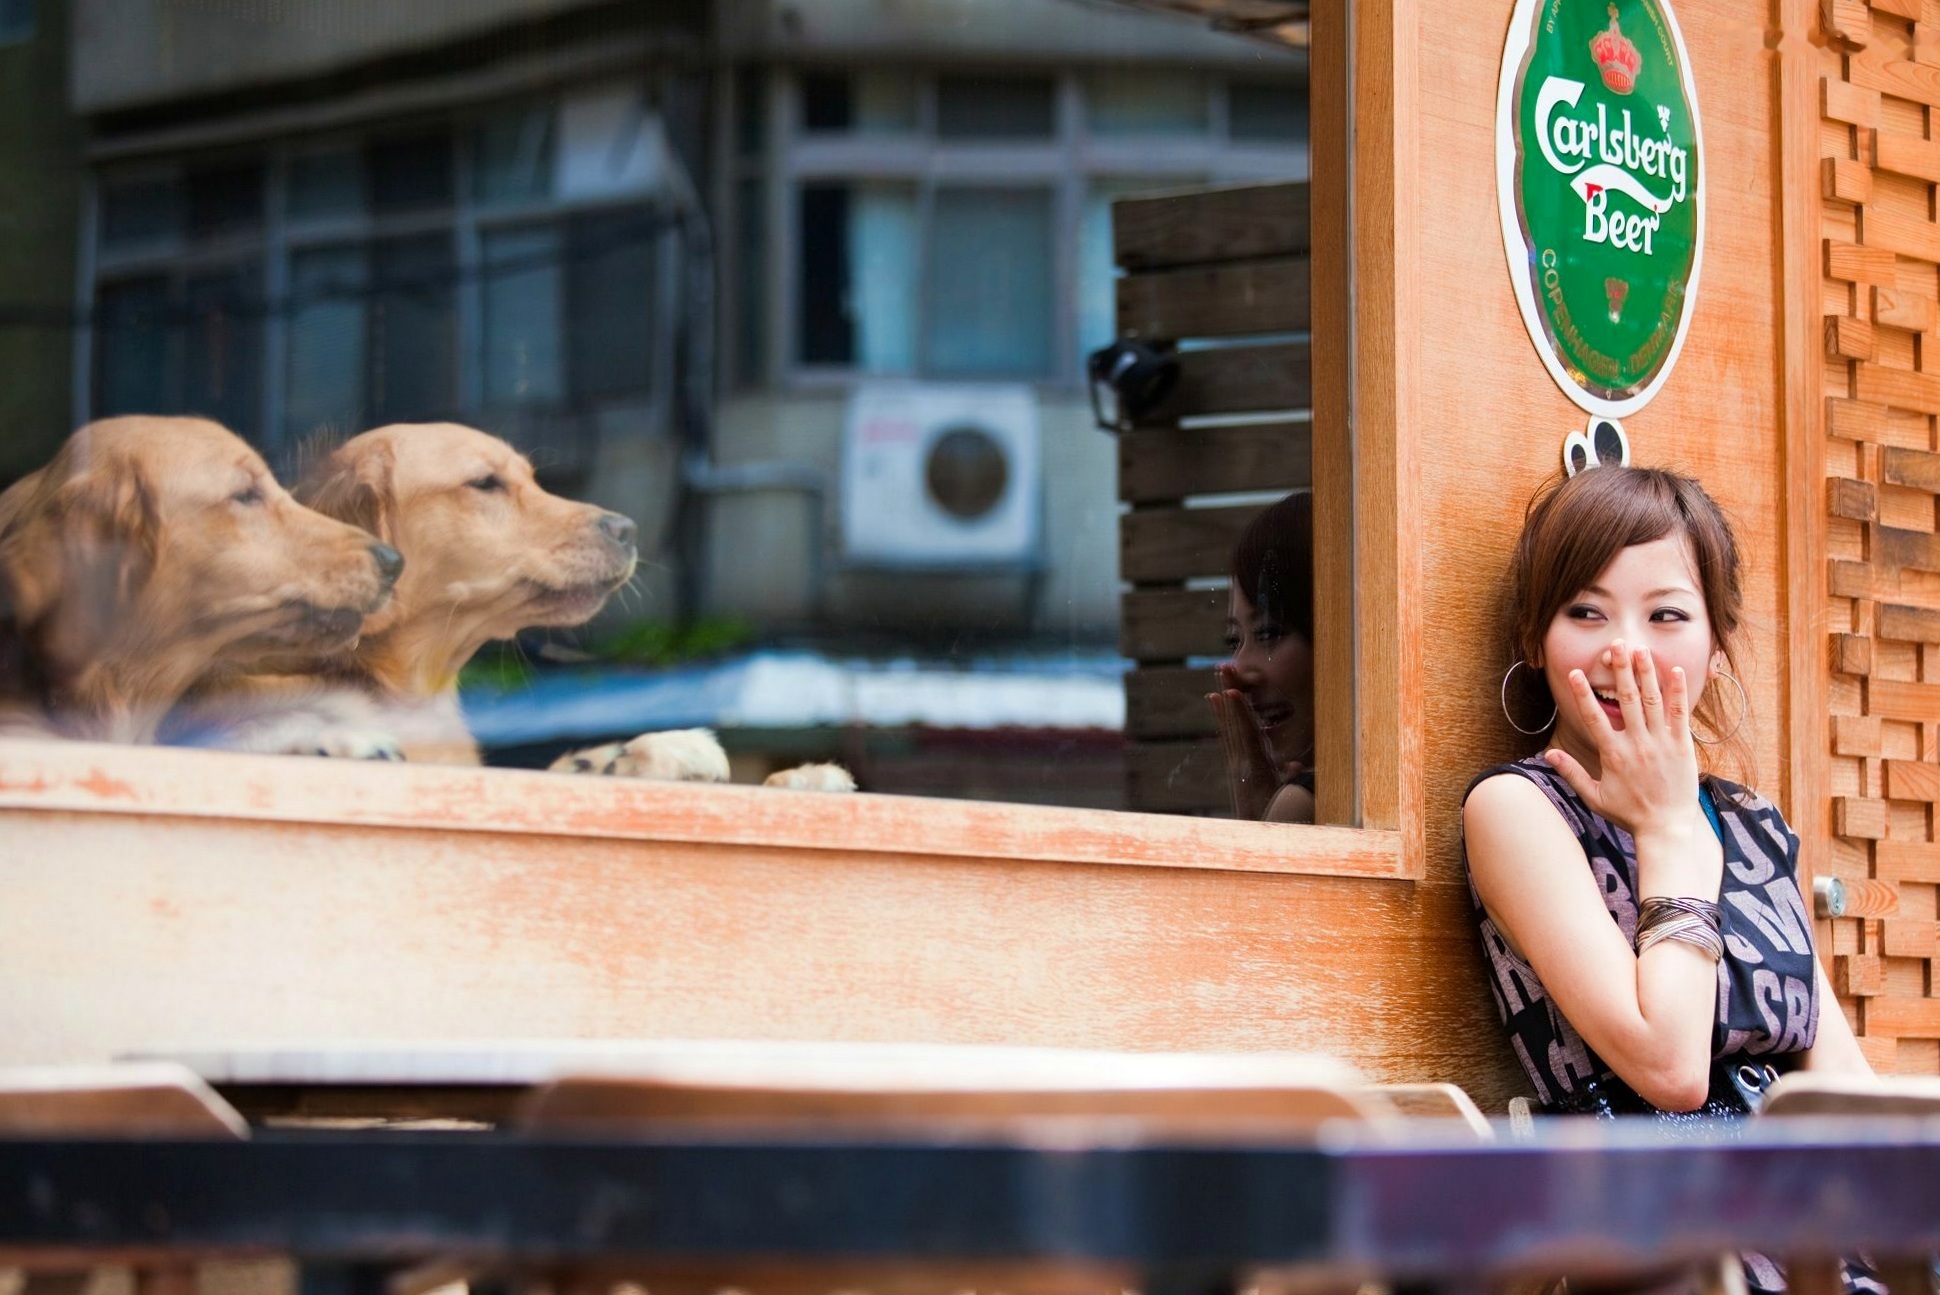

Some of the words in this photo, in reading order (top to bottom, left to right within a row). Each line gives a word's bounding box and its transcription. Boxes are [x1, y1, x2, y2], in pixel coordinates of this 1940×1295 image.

[1546, 18, 1555, 34] BY
[1657, 26, 1674, 67] COURT
[1534, 75, 1688, 204] Carlsberg
[1583, 184, 1660, 256] Beer
